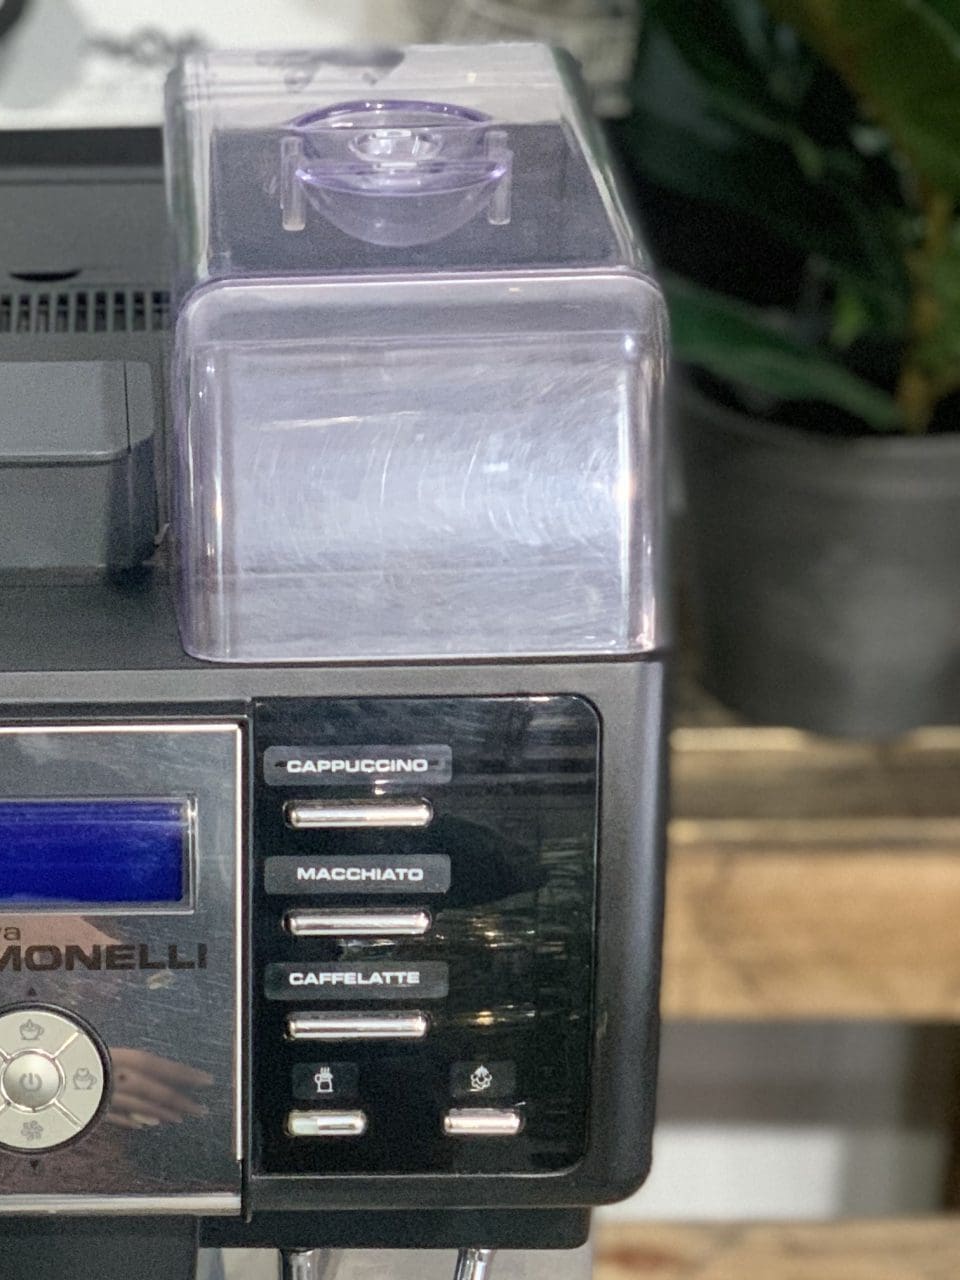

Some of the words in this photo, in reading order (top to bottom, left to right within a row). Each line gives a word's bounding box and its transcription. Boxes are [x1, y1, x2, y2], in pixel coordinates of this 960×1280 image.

[286, 758, 429, 774] CAPPUCCINO
[296, 866, 424, 882] MACCHIATO
[288, 970, 421, 986] CAFFELATTE
